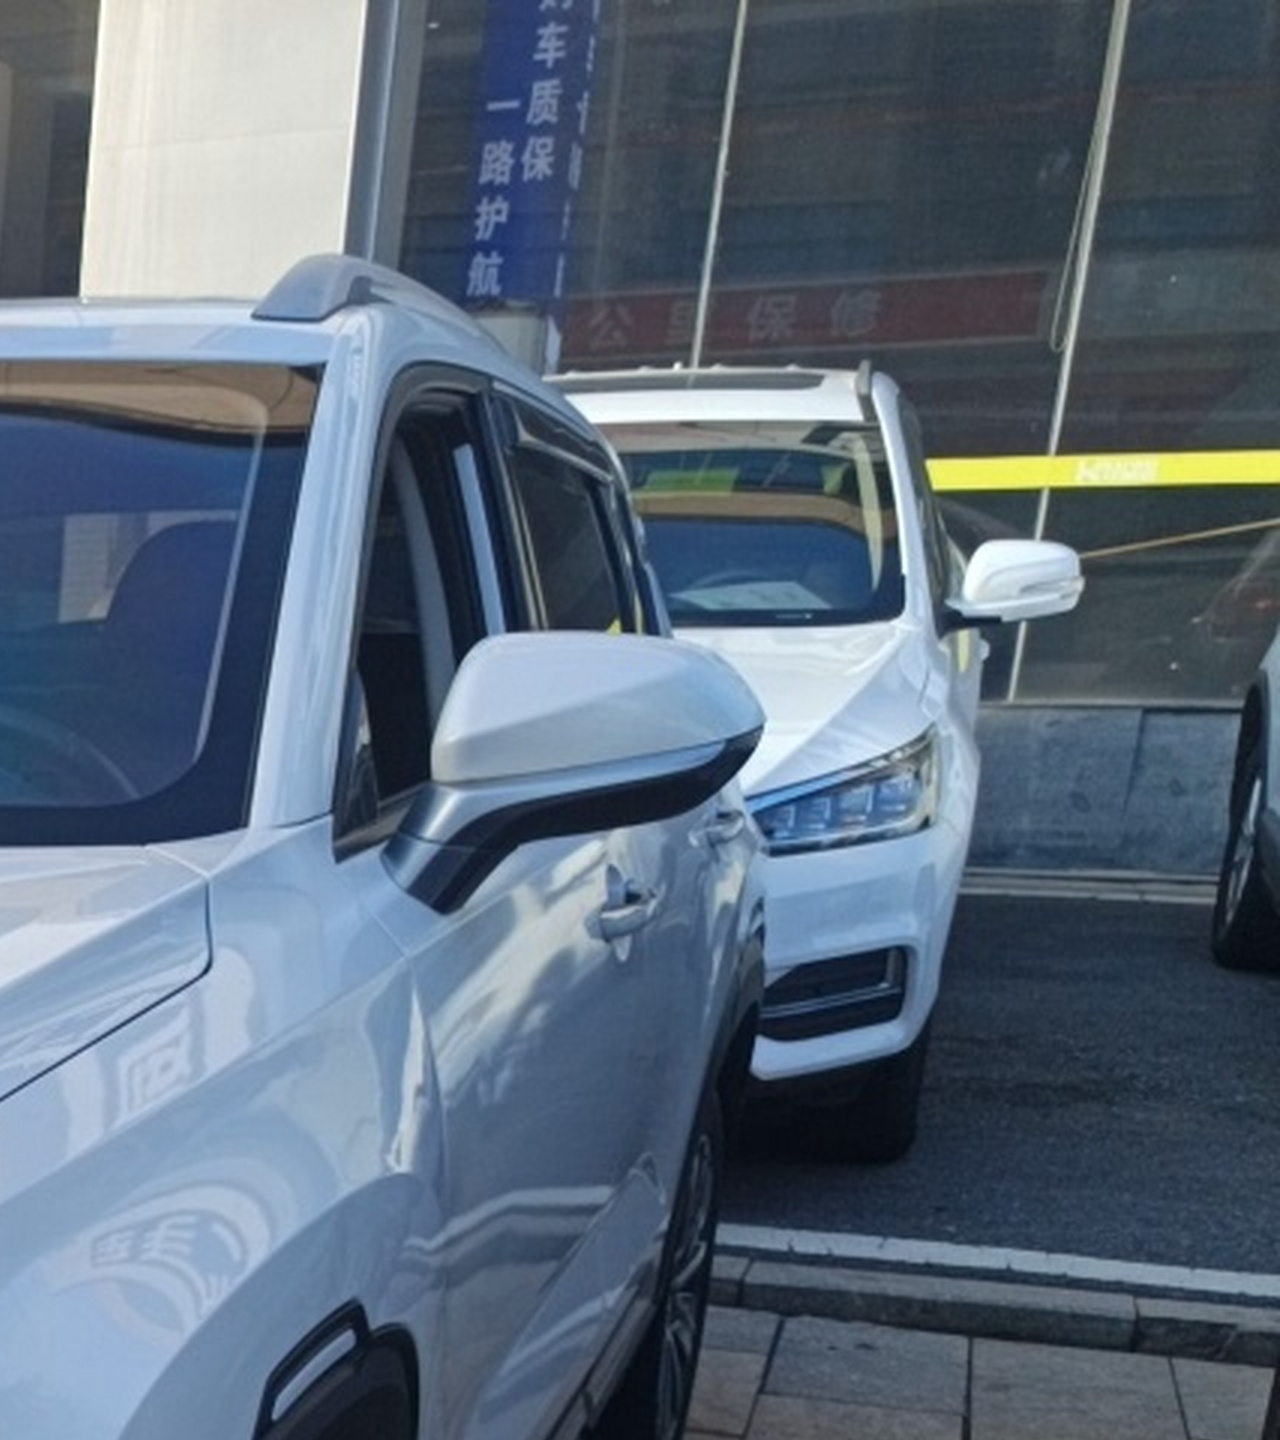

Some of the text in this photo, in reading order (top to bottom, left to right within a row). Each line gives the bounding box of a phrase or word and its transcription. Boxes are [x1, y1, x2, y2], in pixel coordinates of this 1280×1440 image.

[520, 0, 573, 182] 车质保
[466, 98, 521, 297] 一路护航
